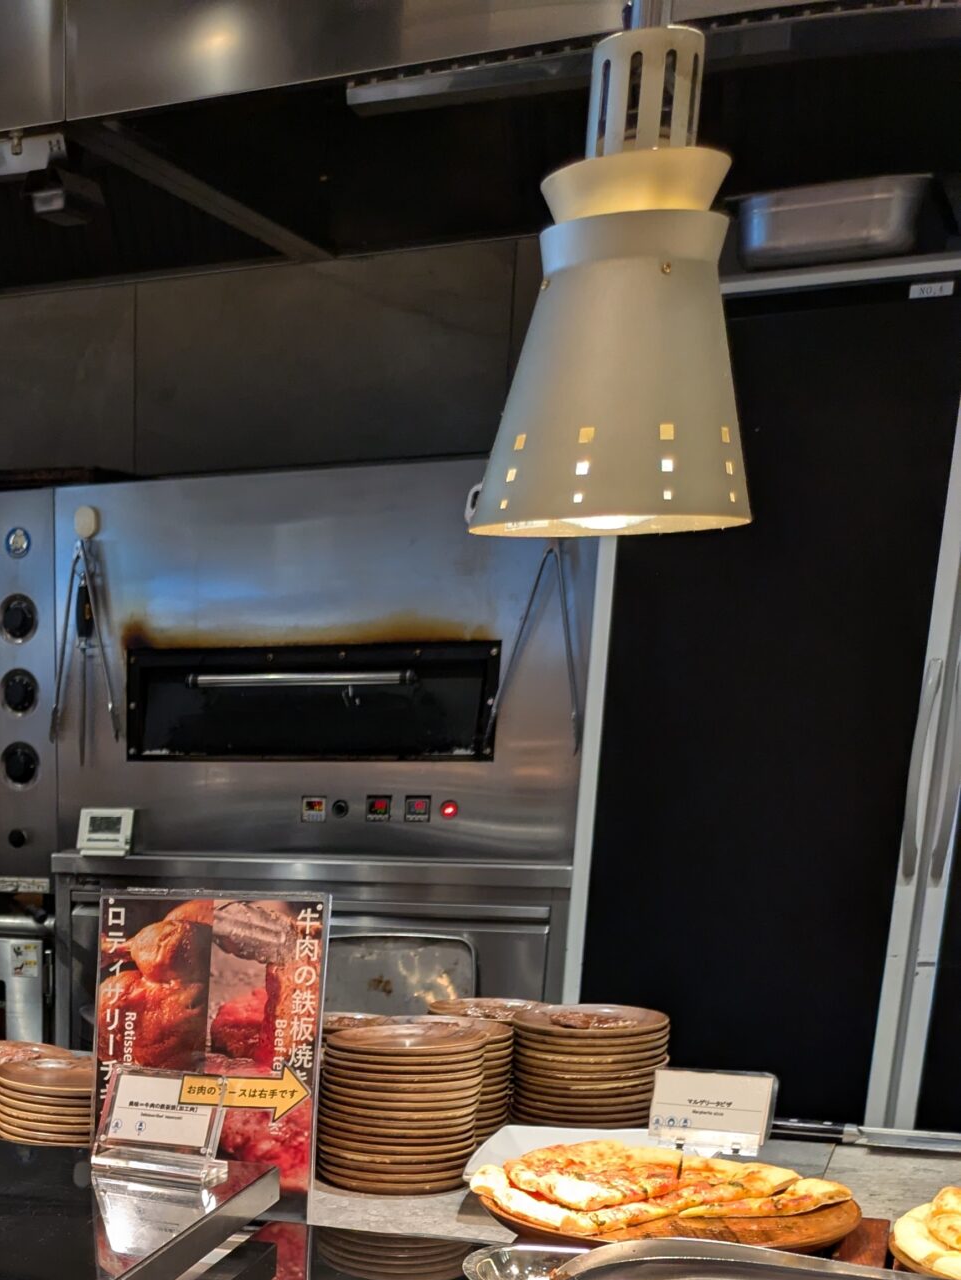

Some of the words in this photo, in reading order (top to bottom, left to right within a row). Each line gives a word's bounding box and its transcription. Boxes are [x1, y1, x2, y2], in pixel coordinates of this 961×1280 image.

[99, 906, 127, 1114] ロティサリーチ
[273, 1019, 288, 1053] Beef
